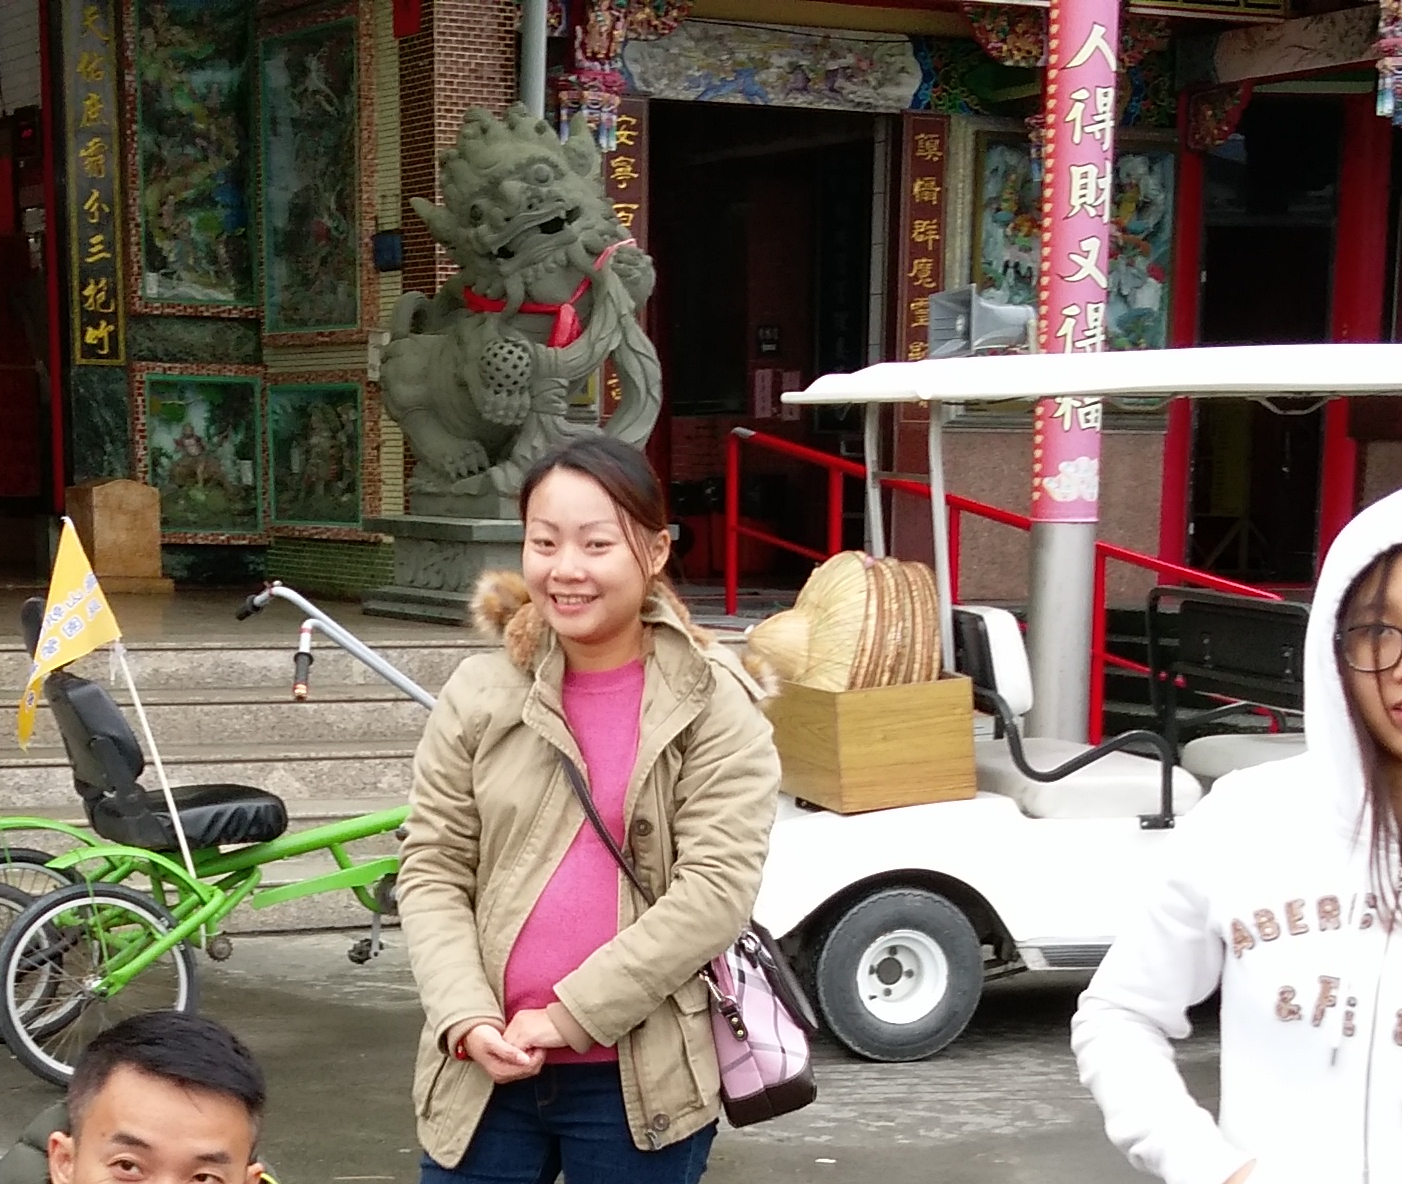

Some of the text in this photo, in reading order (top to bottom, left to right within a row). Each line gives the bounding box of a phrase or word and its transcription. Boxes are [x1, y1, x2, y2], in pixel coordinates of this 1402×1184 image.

[1057, 21, 1117, 432] 人得財又得福
